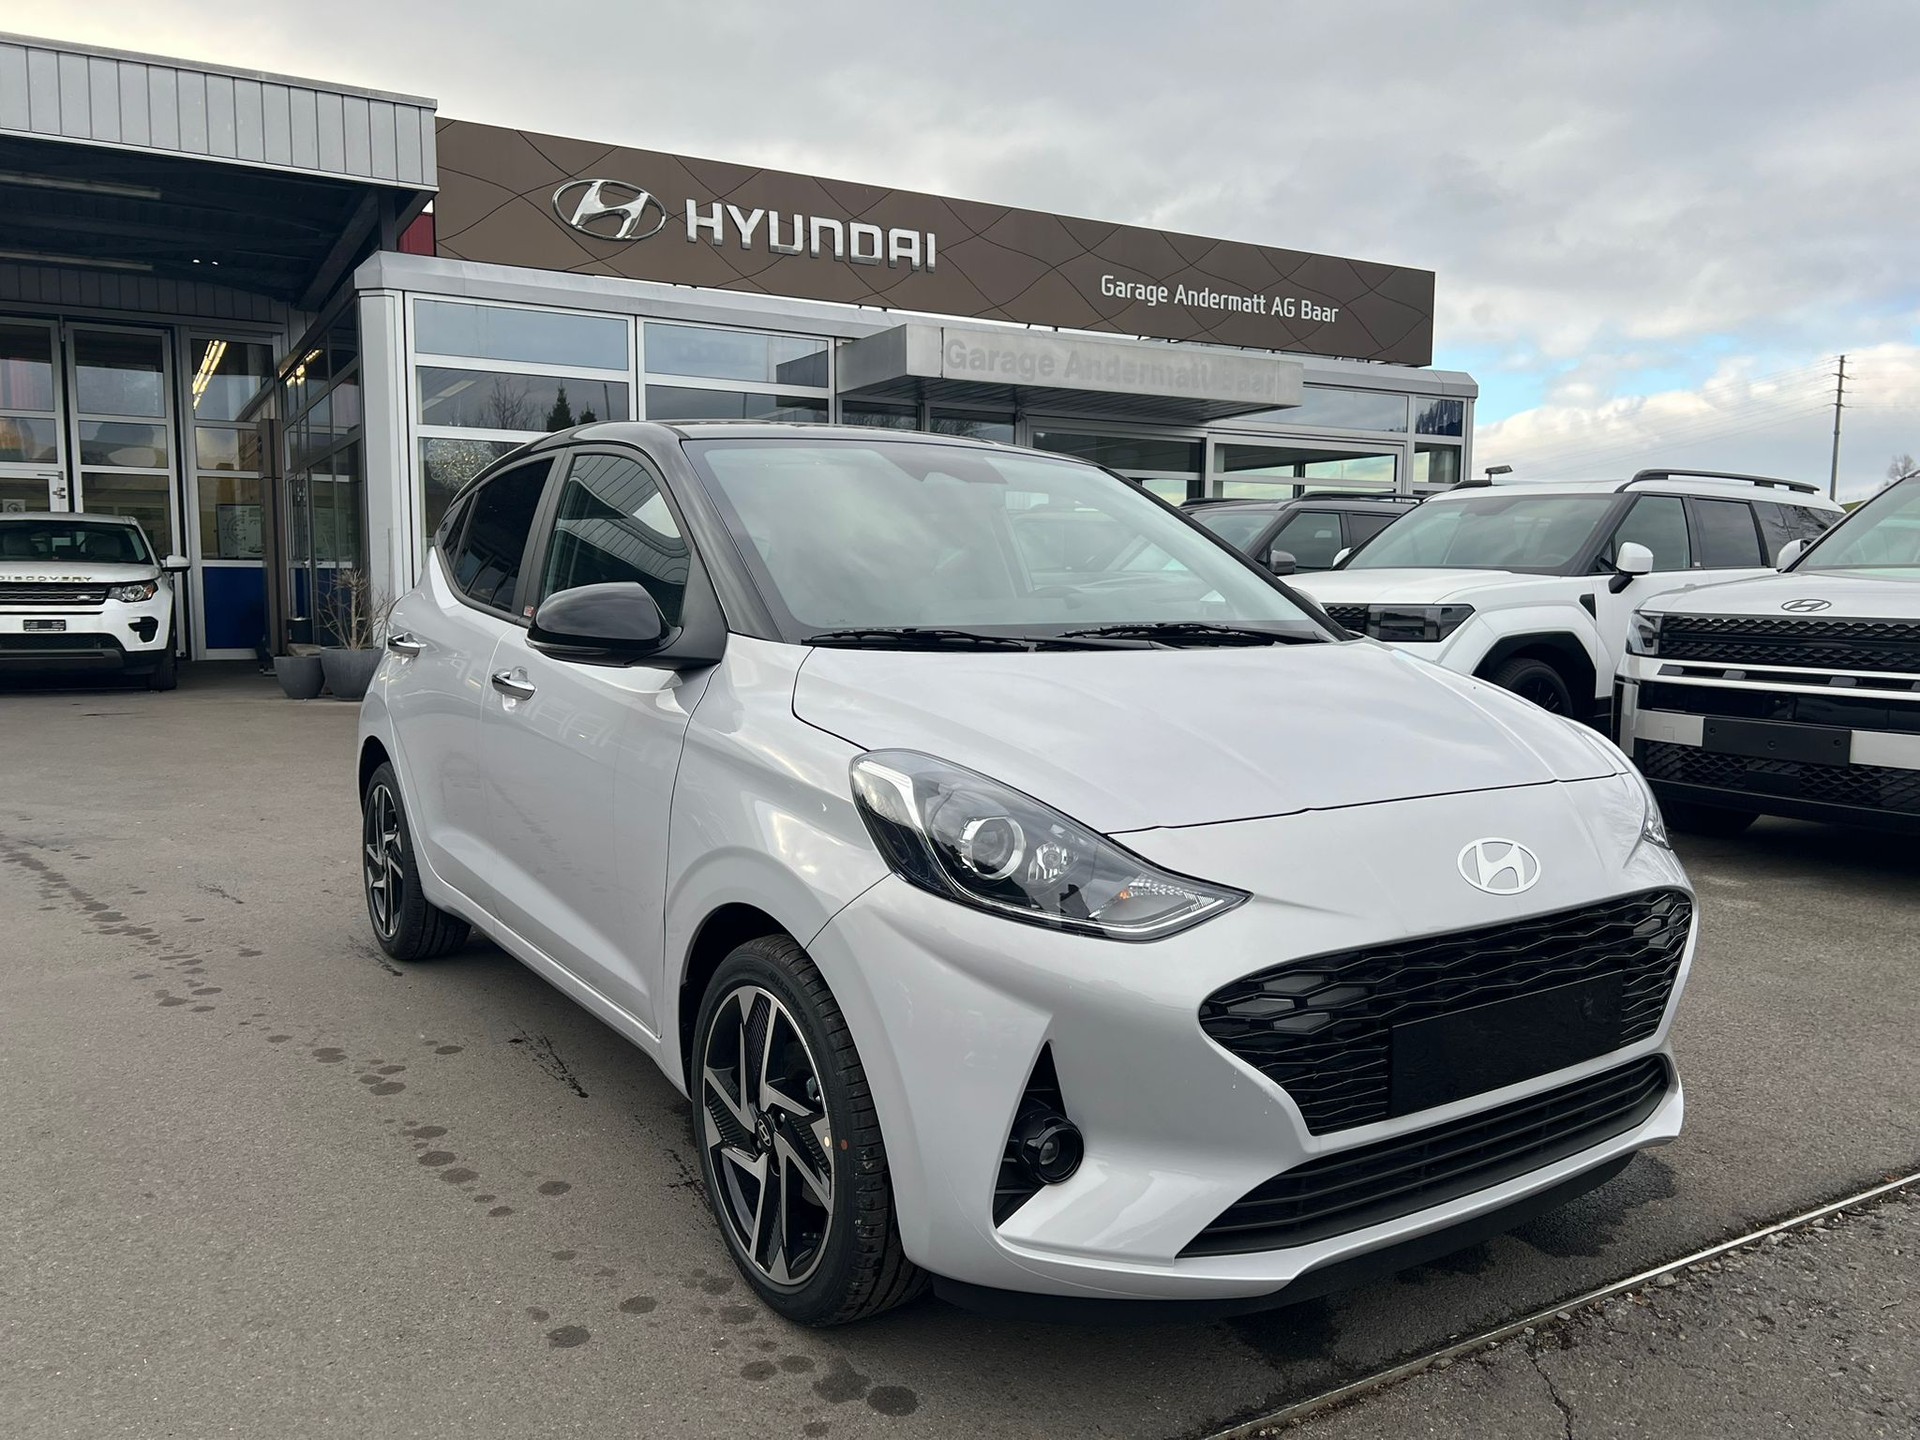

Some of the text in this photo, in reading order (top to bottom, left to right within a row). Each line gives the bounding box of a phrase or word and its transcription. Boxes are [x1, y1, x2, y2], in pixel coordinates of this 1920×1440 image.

[686, 198, 936, 272] HYUNDAI
[1100, 274, 1339, 323] Garage Andermatt AG Baar
[945, 338, 1055, 380] Garage
